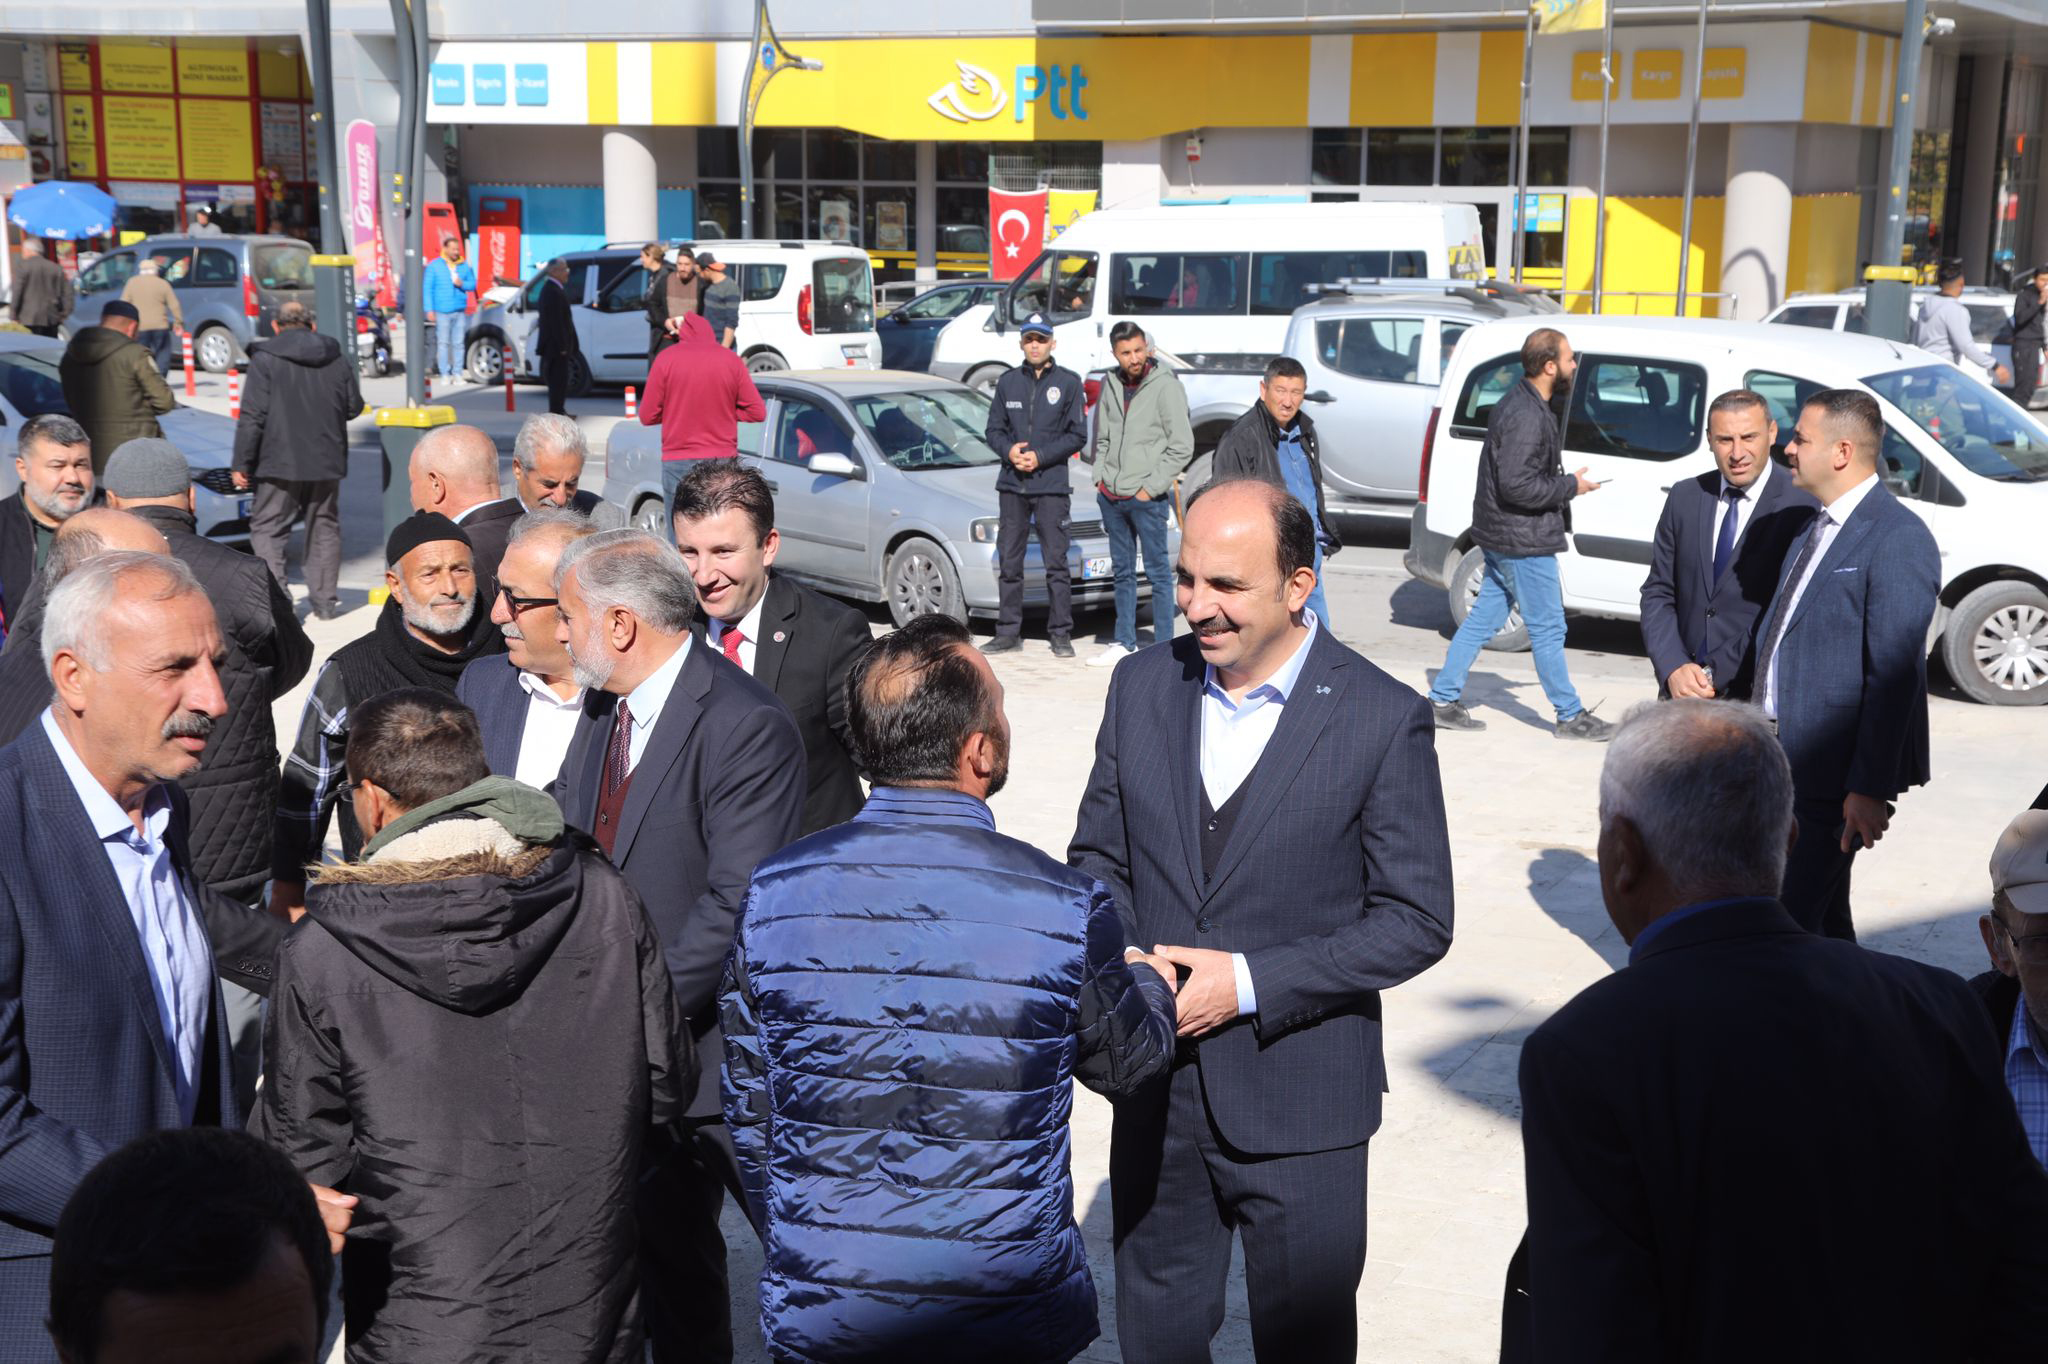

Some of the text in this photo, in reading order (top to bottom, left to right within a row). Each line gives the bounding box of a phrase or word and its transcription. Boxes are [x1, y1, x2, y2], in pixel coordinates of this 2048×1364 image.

[1015, 65, 1089, 121] Ptt
[1005, 400, 1023, 409] ABITA
[1091, 559, 1106, 574] 42
